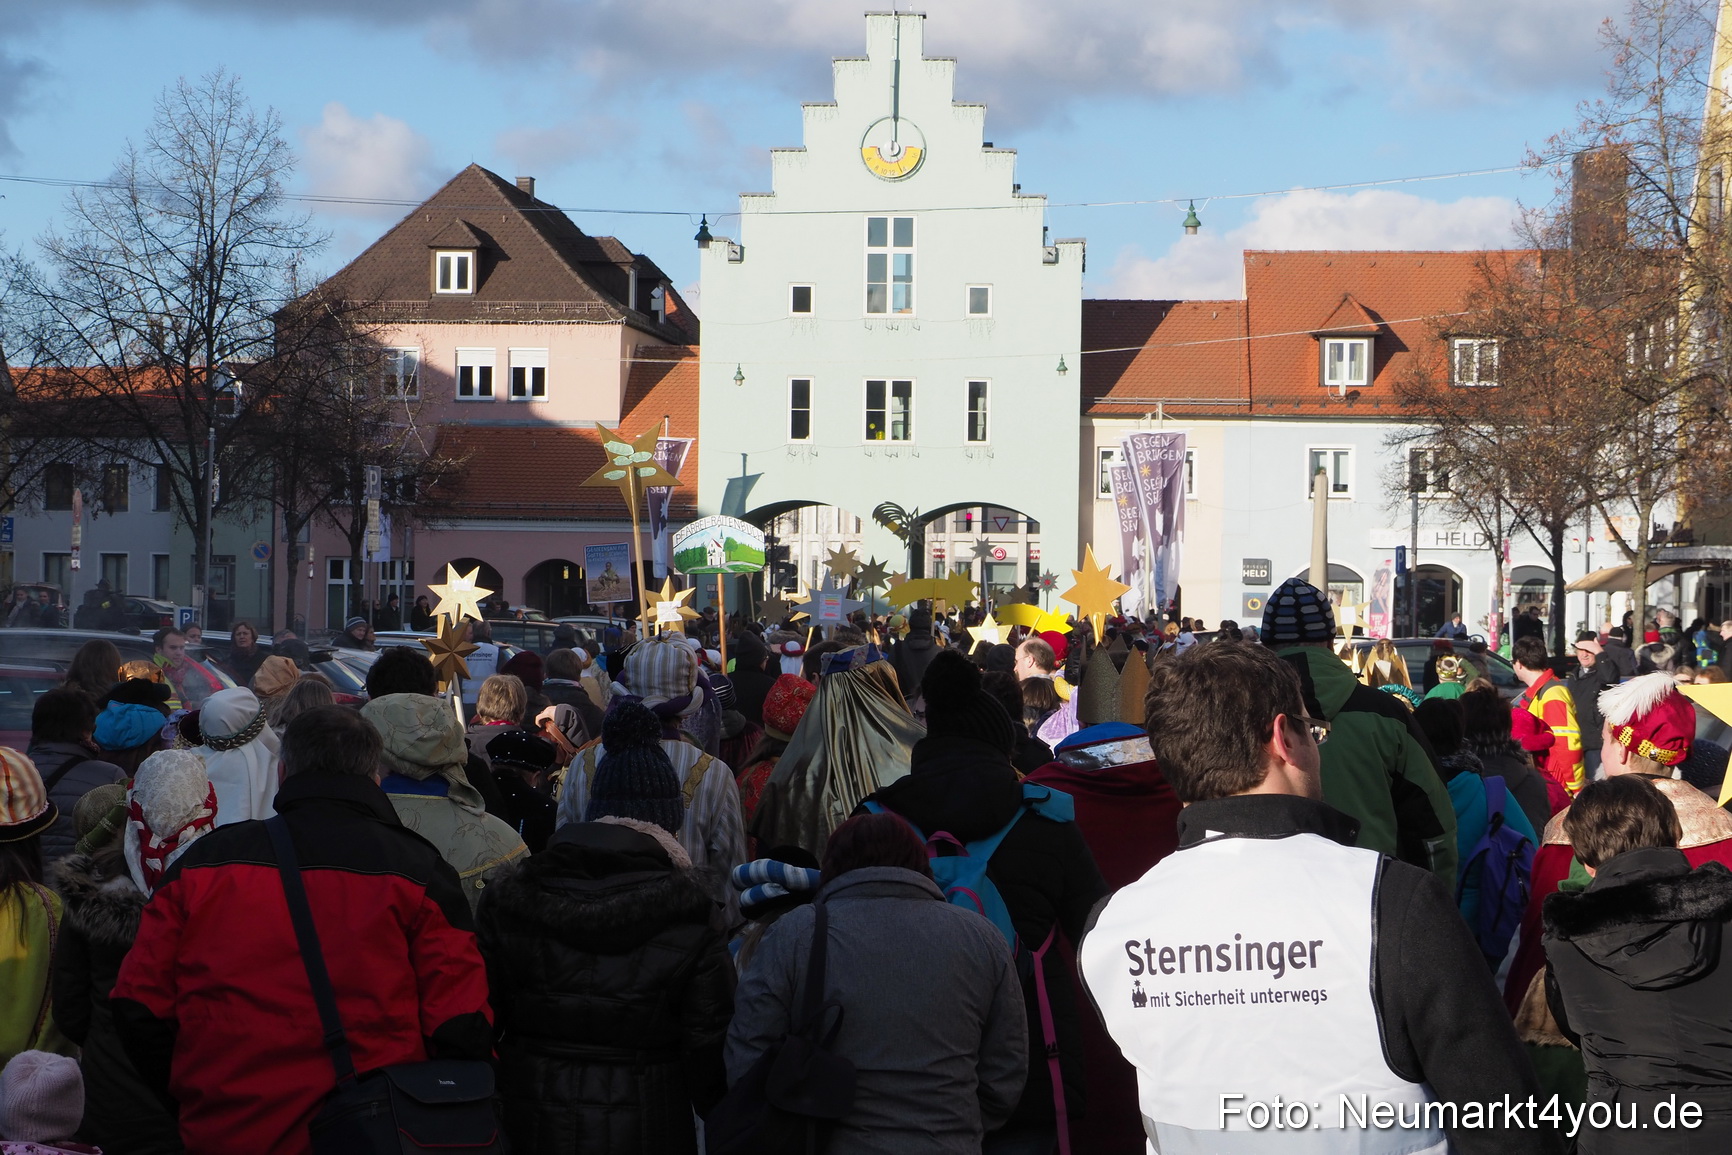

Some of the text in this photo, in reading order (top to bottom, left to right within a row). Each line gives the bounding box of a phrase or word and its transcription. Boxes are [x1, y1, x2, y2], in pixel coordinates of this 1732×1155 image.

[1133, 436, 1172, 450] SEGEN
[369, 470, 378, 494] P
[1435, 532, 1486, 546] HELD
[1397, 549, 1405, 571] P
[1243, 569, 1268, 578] HELD
[182, 612, 191, 624] P
[1124, 932, 1324, 980] Sternsinger
[1150, 987, 1328, 1008] mit Sicherheit unterwegs
